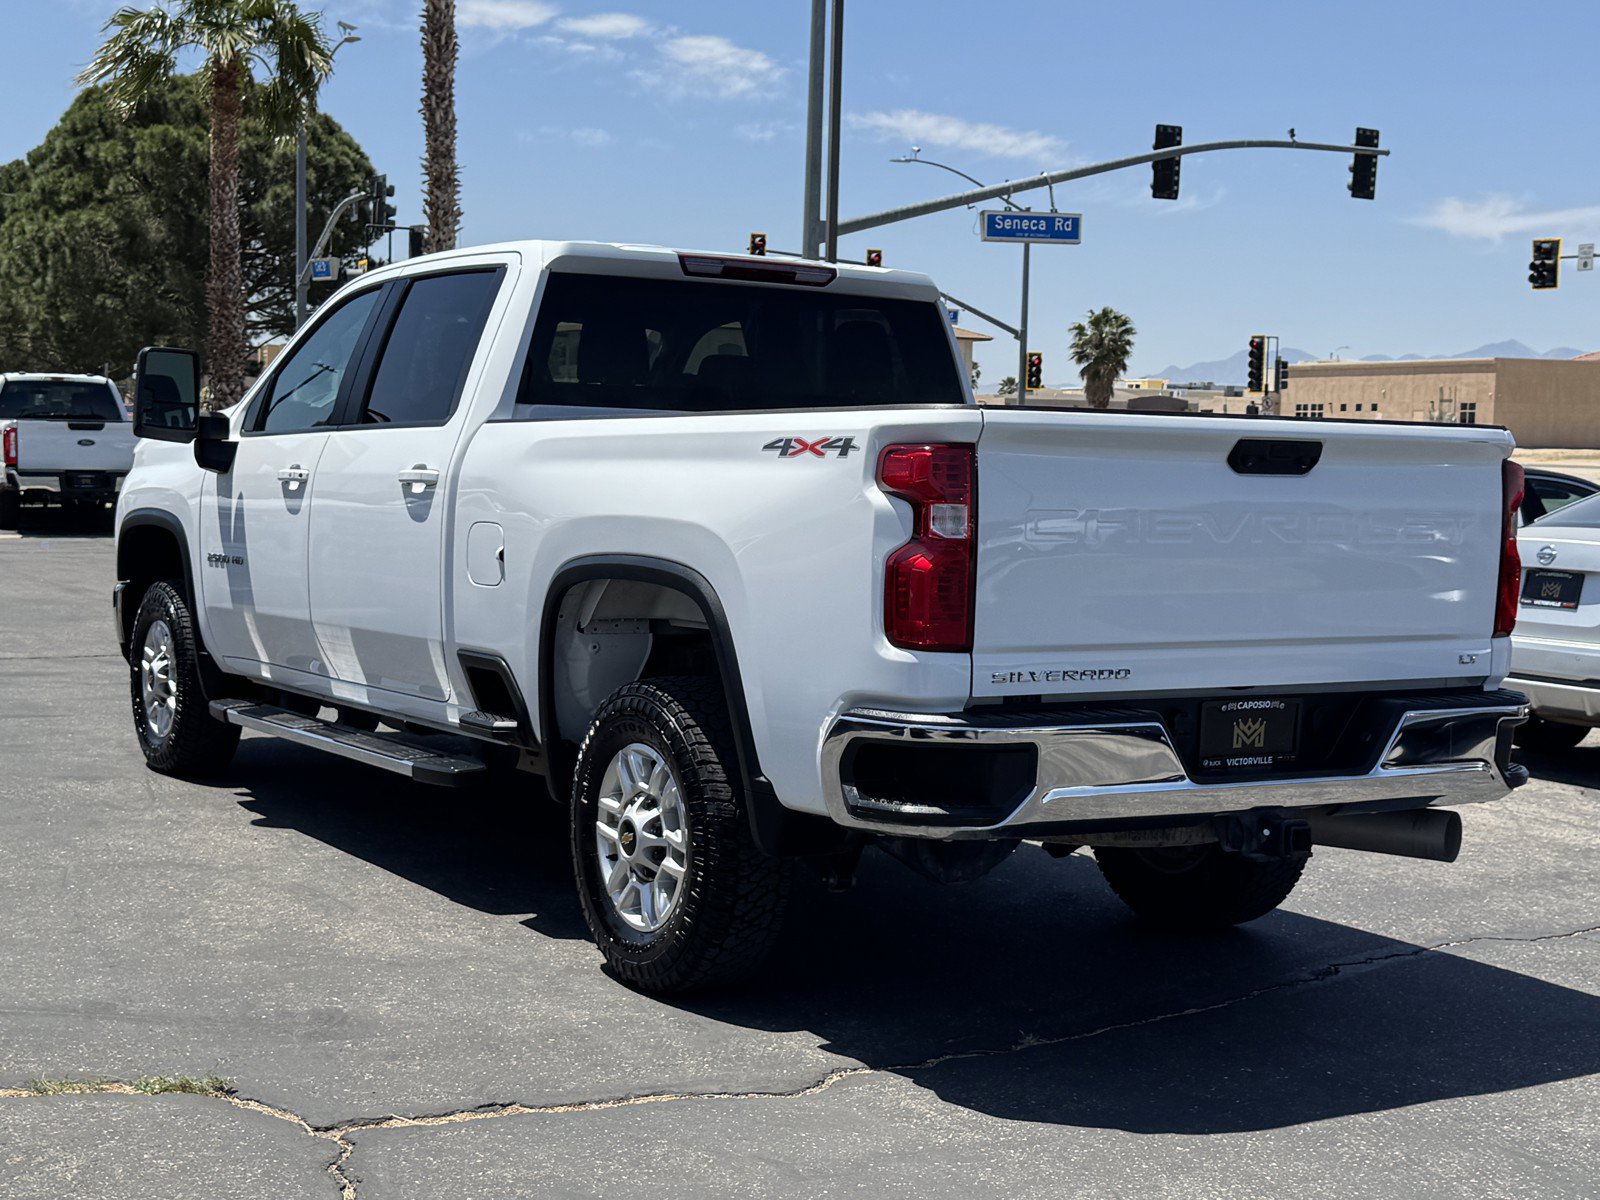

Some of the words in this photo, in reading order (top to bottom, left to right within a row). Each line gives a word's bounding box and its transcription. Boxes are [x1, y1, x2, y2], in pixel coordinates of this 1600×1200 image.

[994, 215, 1046, 231] Seneca
[1054, 217, 1073, 232] Rd
[991, 668, 1132, 684] SILVERADO
[1237, 700, 1271, 710] CAPOSIO
[1226, 756, 1273, 767] VICTORVILLE
